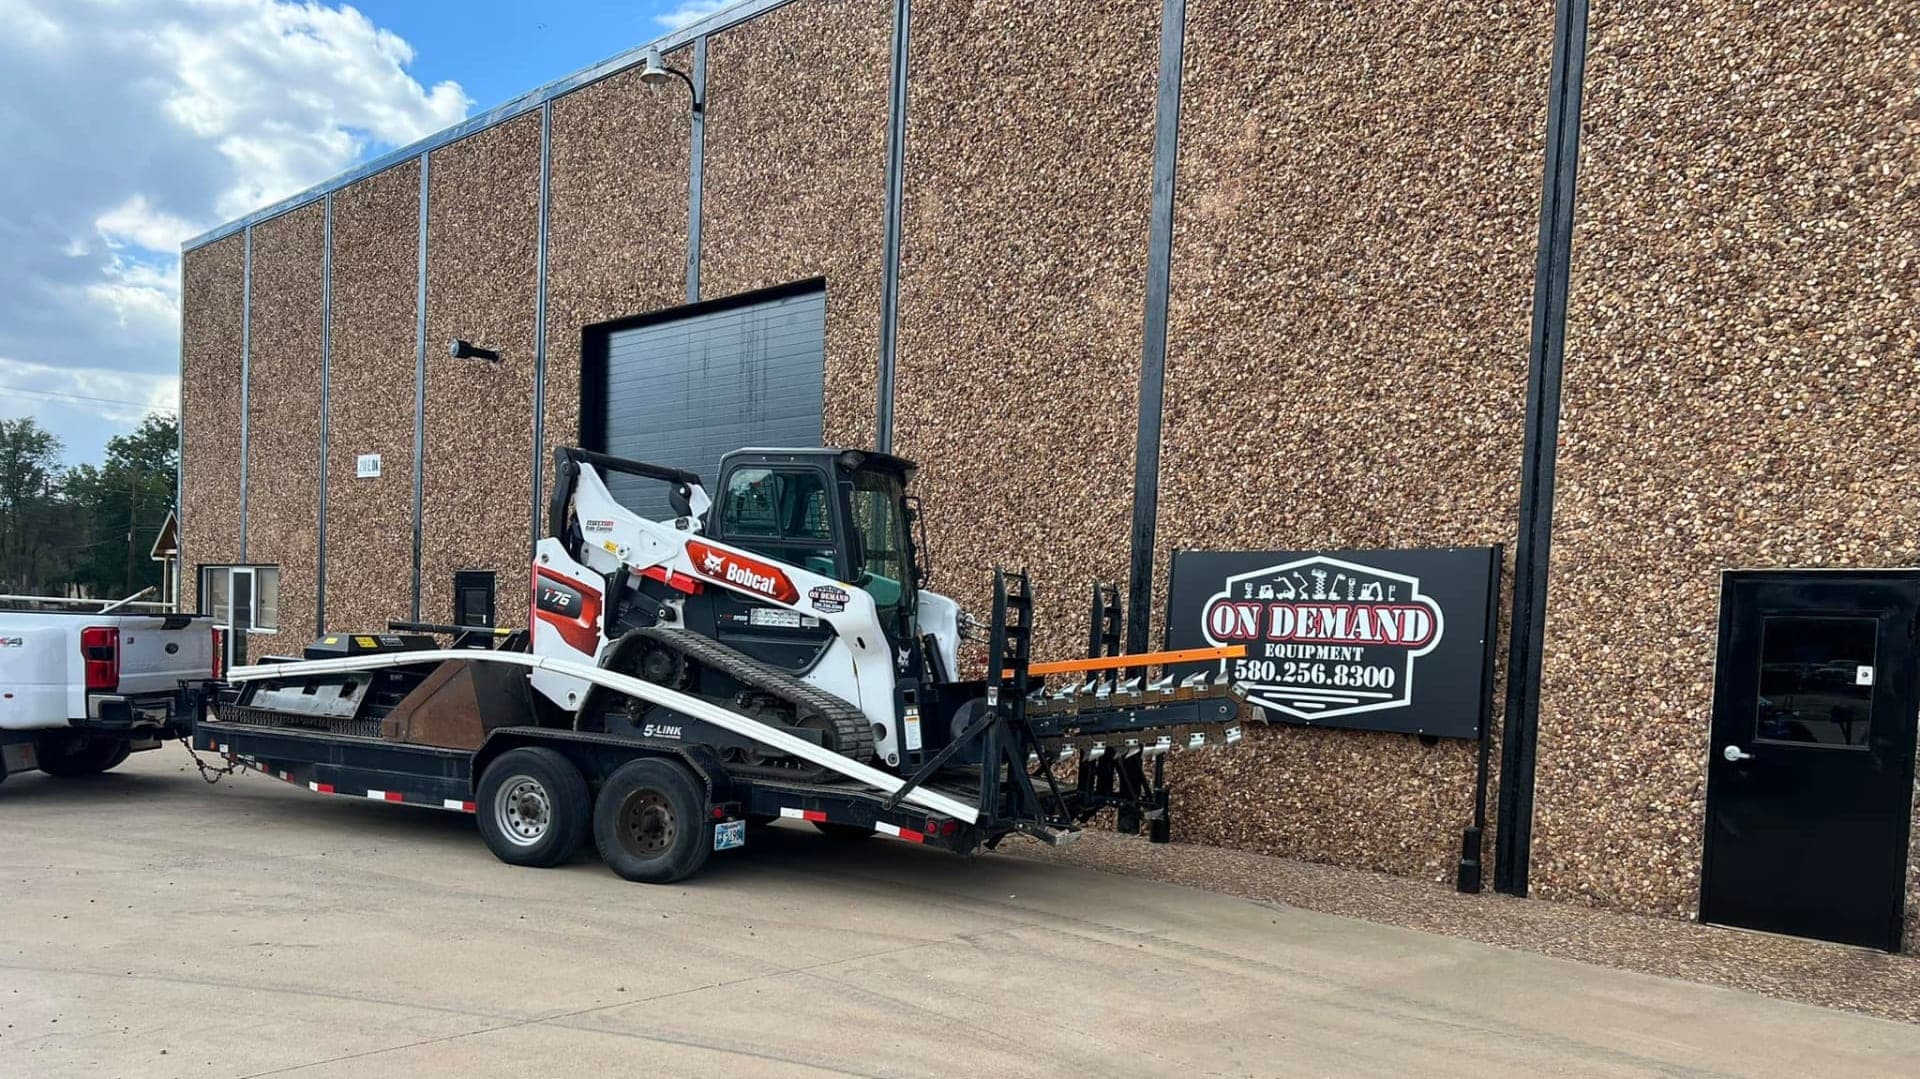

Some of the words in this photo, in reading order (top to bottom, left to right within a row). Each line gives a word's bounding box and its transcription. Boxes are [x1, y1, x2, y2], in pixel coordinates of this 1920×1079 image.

[726, 562, 777, 595] Bobcat
[543, 587, 572, 606] T76
[1211, 603, 1260, 638] ON
[1268, 605, 1432, 644] DEMAND
[1264, 643, 1364, 662] EQUIPMENT
[1234, 659, 1396, 689] 580.256.8300
[643, 724, 683, 738] 5-LINK
